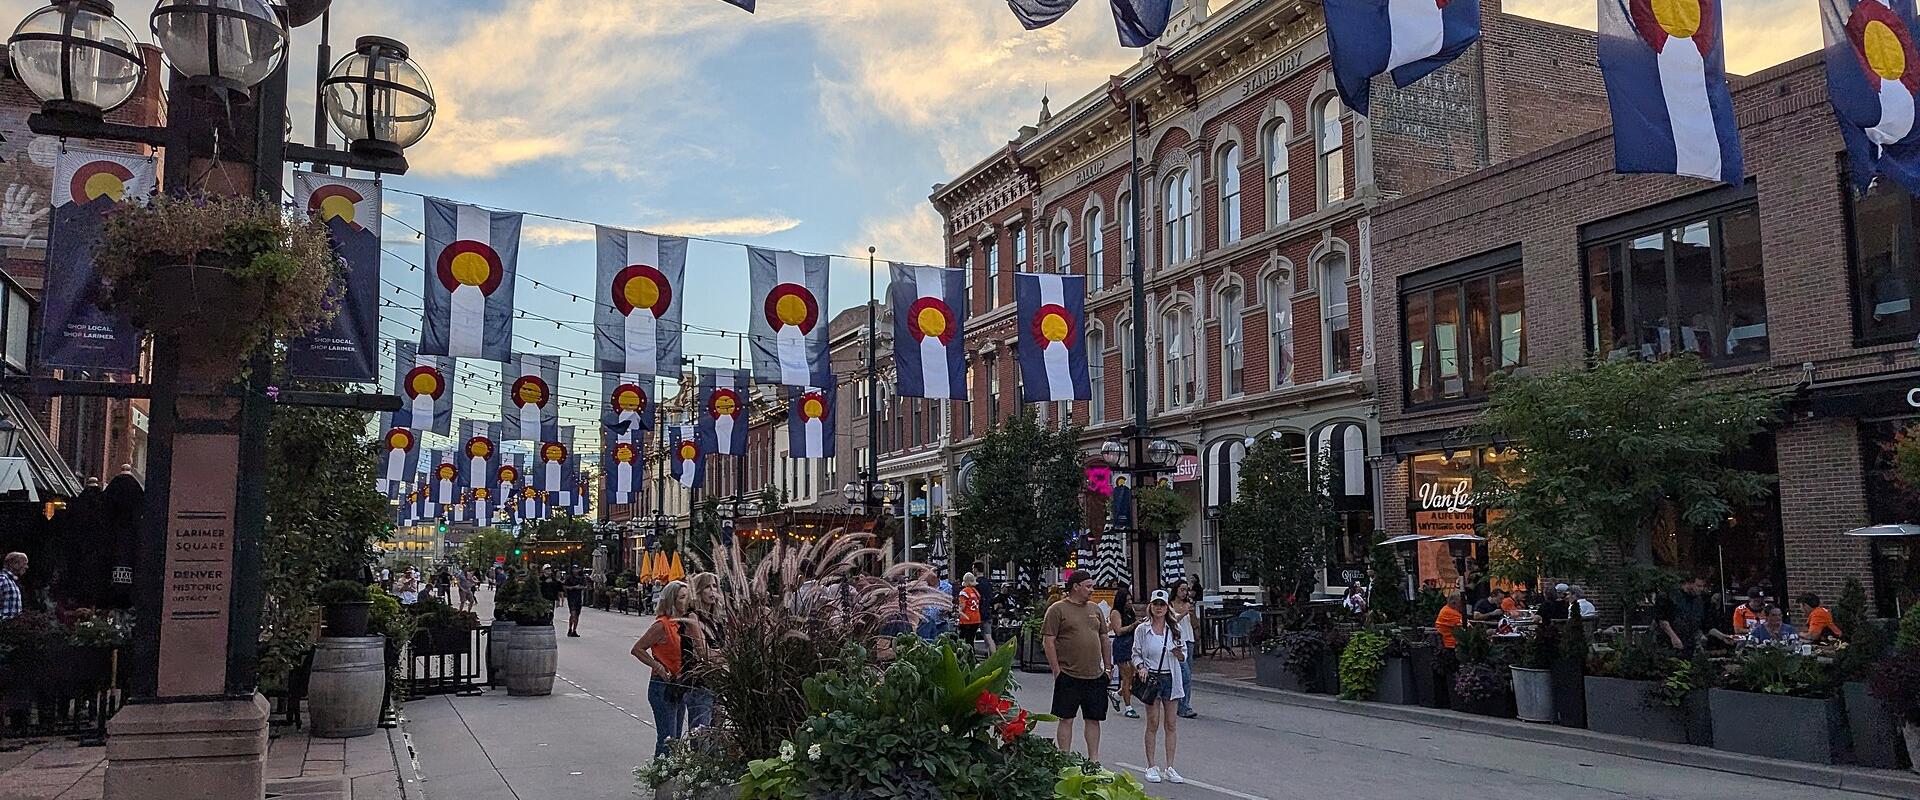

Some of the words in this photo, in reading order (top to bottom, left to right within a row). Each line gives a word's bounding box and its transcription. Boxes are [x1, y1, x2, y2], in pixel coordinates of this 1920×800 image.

[1242, 51, 1303, 96] STANBURY
[1076, 160, 1105, 185] GALLUP
[1419, 482, 1453, 510] Van
[176, 529, 225, 537] LARIMER
[175, 542, 225, 552] SQUARE
[174, 571, 223, 579] DENVER
[172, 583, 224, 591] HISTORIC
